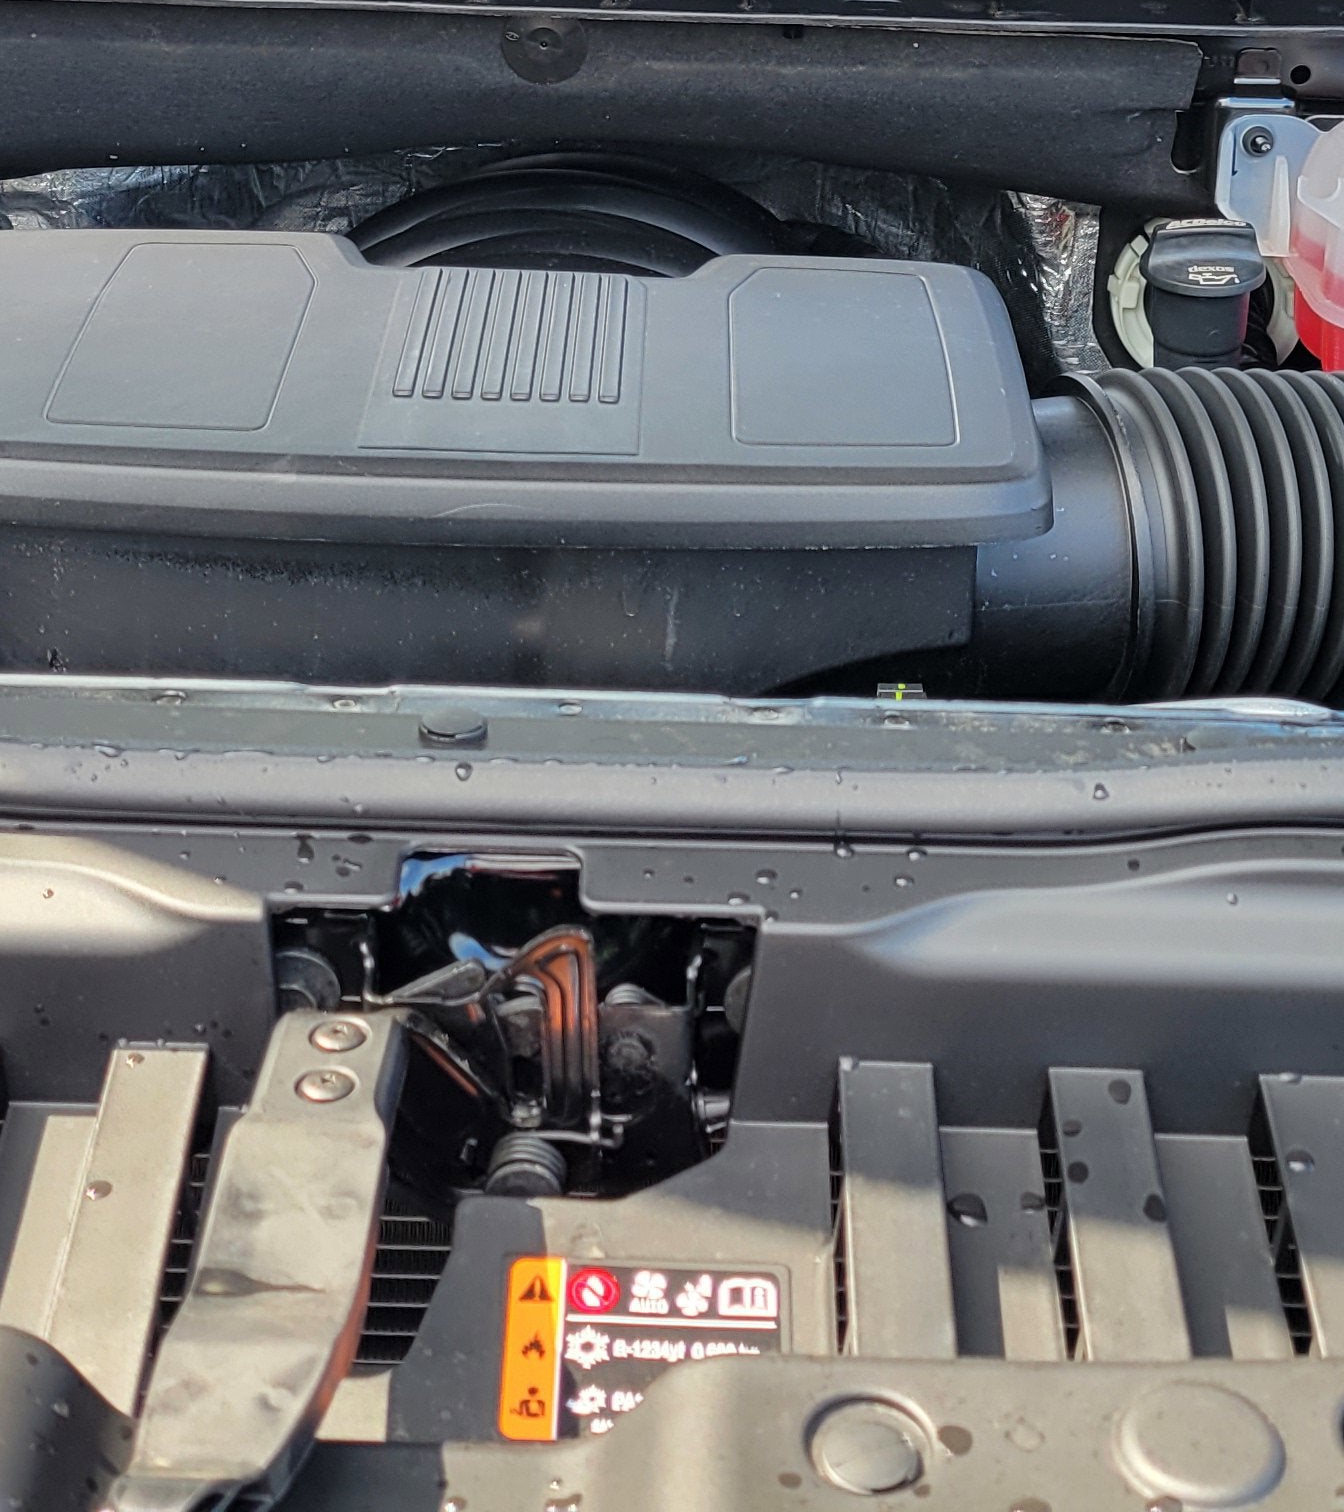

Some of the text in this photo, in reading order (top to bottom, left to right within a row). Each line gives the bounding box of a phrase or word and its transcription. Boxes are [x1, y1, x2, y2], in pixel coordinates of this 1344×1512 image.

[1166, 218, 1247, 230] ACDelco
[1187, 265, 1235, 273] dexos
[628, 1298, 670, 1315] AUTO
